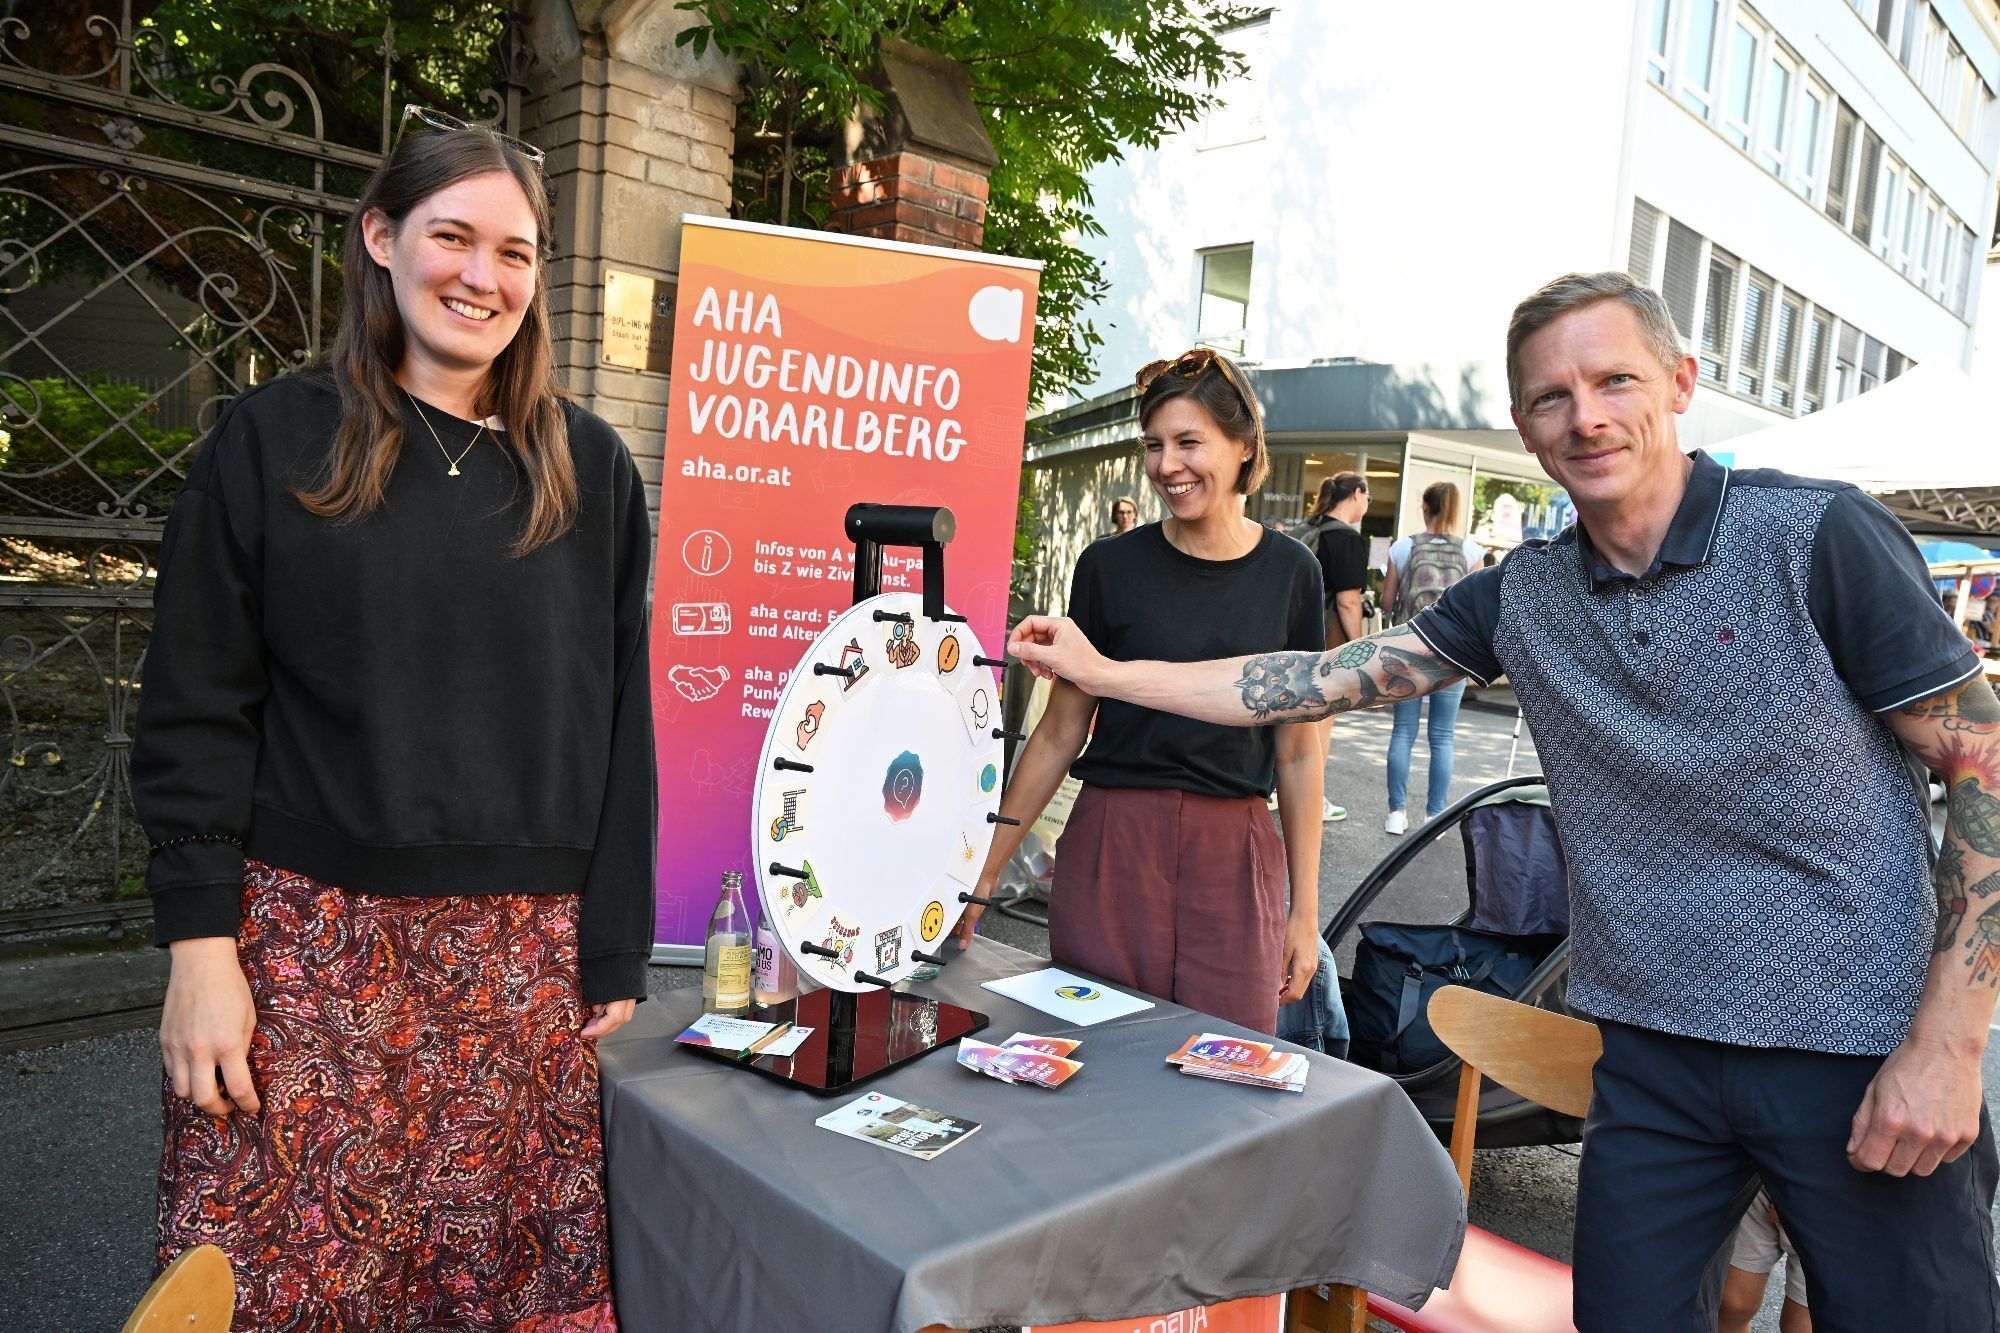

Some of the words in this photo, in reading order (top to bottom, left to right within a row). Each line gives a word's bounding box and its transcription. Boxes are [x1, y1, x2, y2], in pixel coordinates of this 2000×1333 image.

[692, 286, 782, 338] AHA
[689, 339, 961, 411] JUGENDINFO
[688, 390, 968, 462] VORARLBERG
[681, 455, 792, 487] aha.or.at
[755, 539, 794, 557] Infos
[799, 546, 827, 561] von
[831, 547, 843, 562] A
[882, 552, 924, 572] Au-pa
[753, 559, 777, 575] bis
[781, 561, 792, 576] Z
[796, 565, 823, 579] wie
[750, 603, 779, 619] aha
[783, 607, 822, 623] card:
[748, 623, 778, 638] und
[744, 666, 773, 682] aha
[743, 684, 783, 700] Punk
[741, 703, 775, 719] Rew
